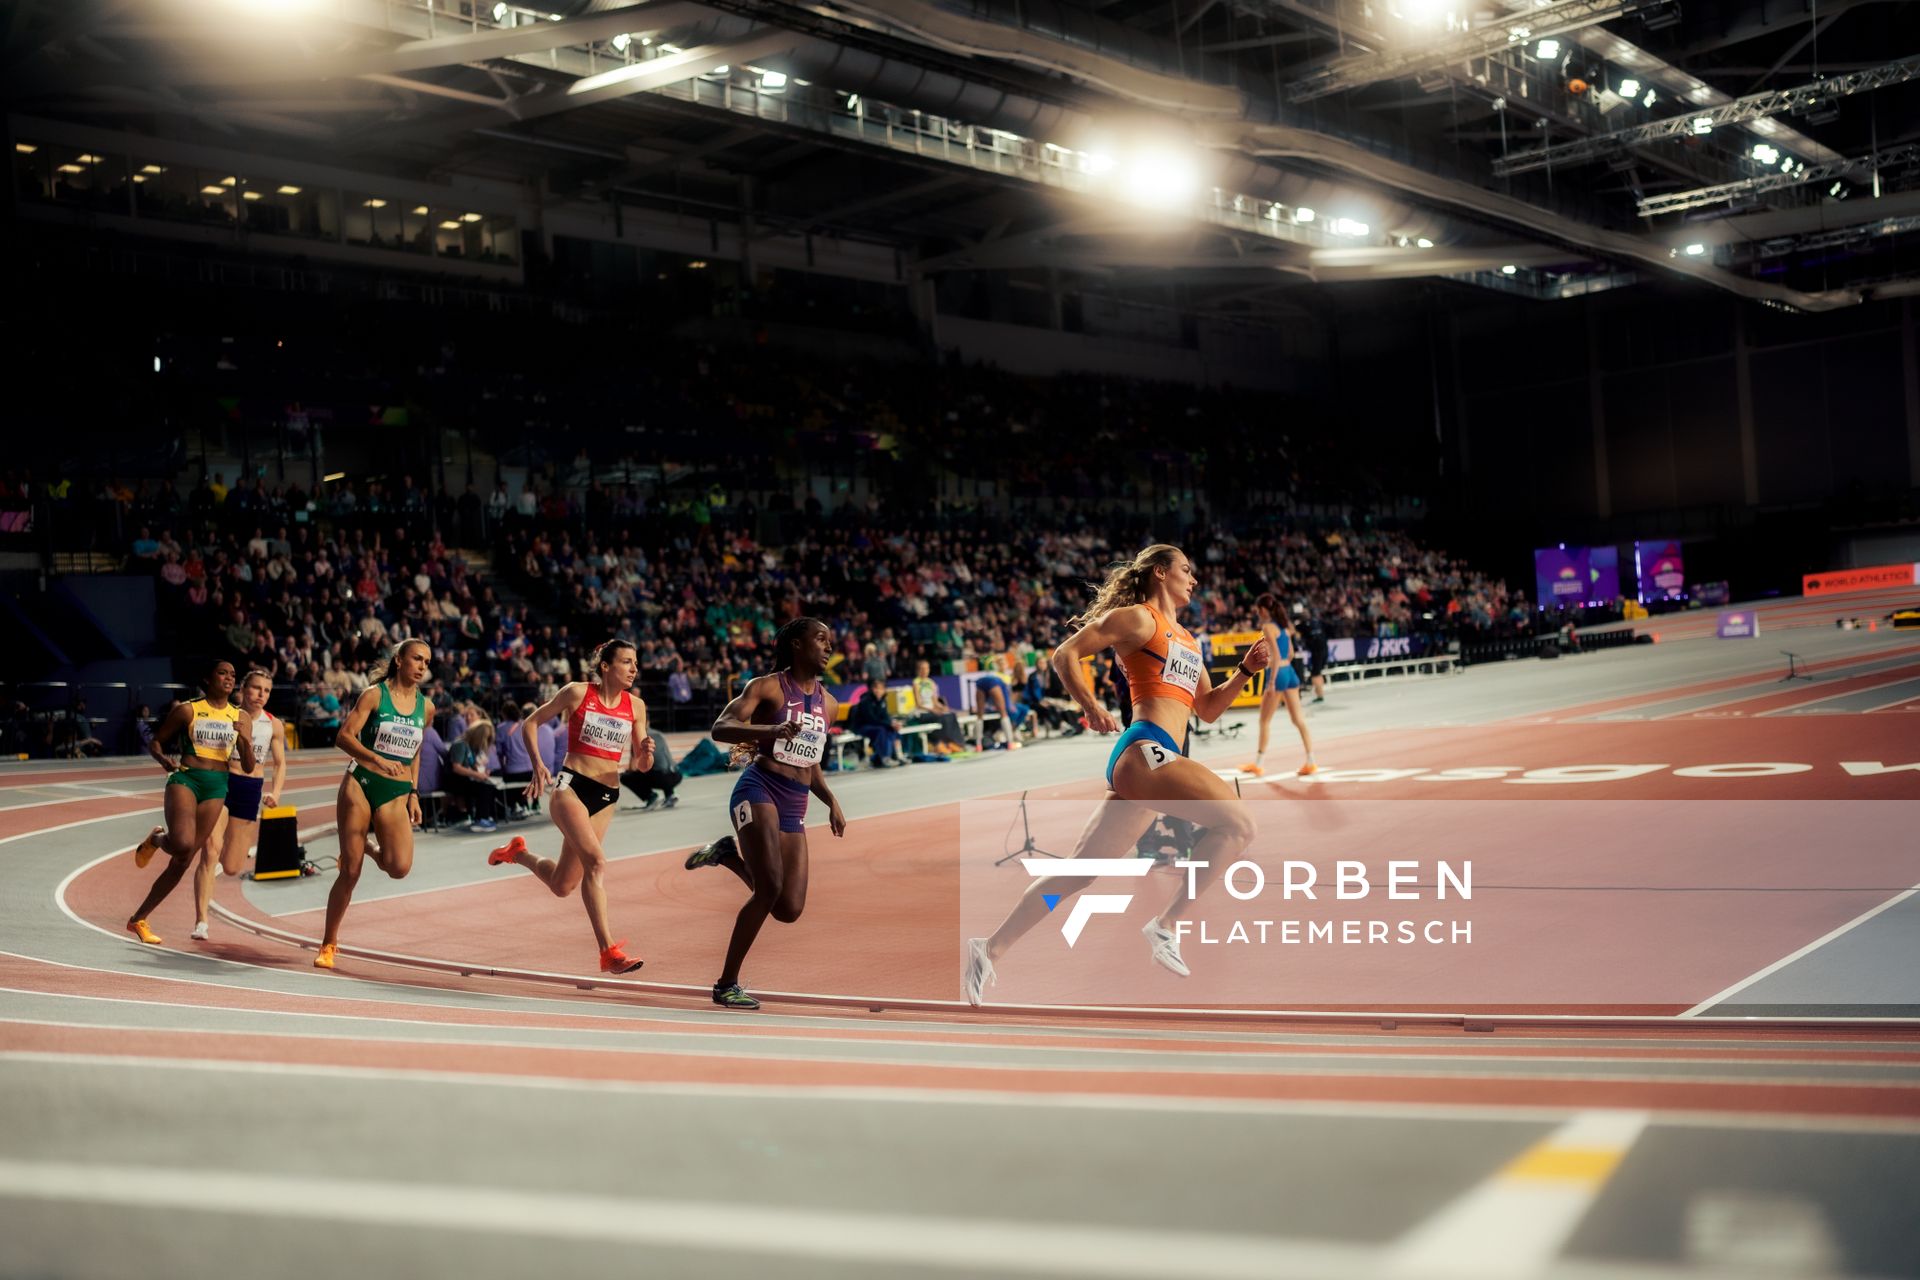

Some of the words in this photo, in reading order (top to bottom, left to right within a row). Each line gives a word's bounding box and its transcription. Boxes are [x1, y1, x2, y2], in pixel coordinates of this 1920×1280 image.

[1825, 577, 1857, 587] WORLD
[1859, 571, 1909, 583] ATHLETICS
[786, 709, 825, 733] USA
[196, 730, 234, 742] WILLIAMS
[378, 733, 418, 749] MAWDSLEY
[784, 740, 818, 759] DIGGS
[1151, 746, 1165, 763] 5
[739, 806, 747, 823] 6
